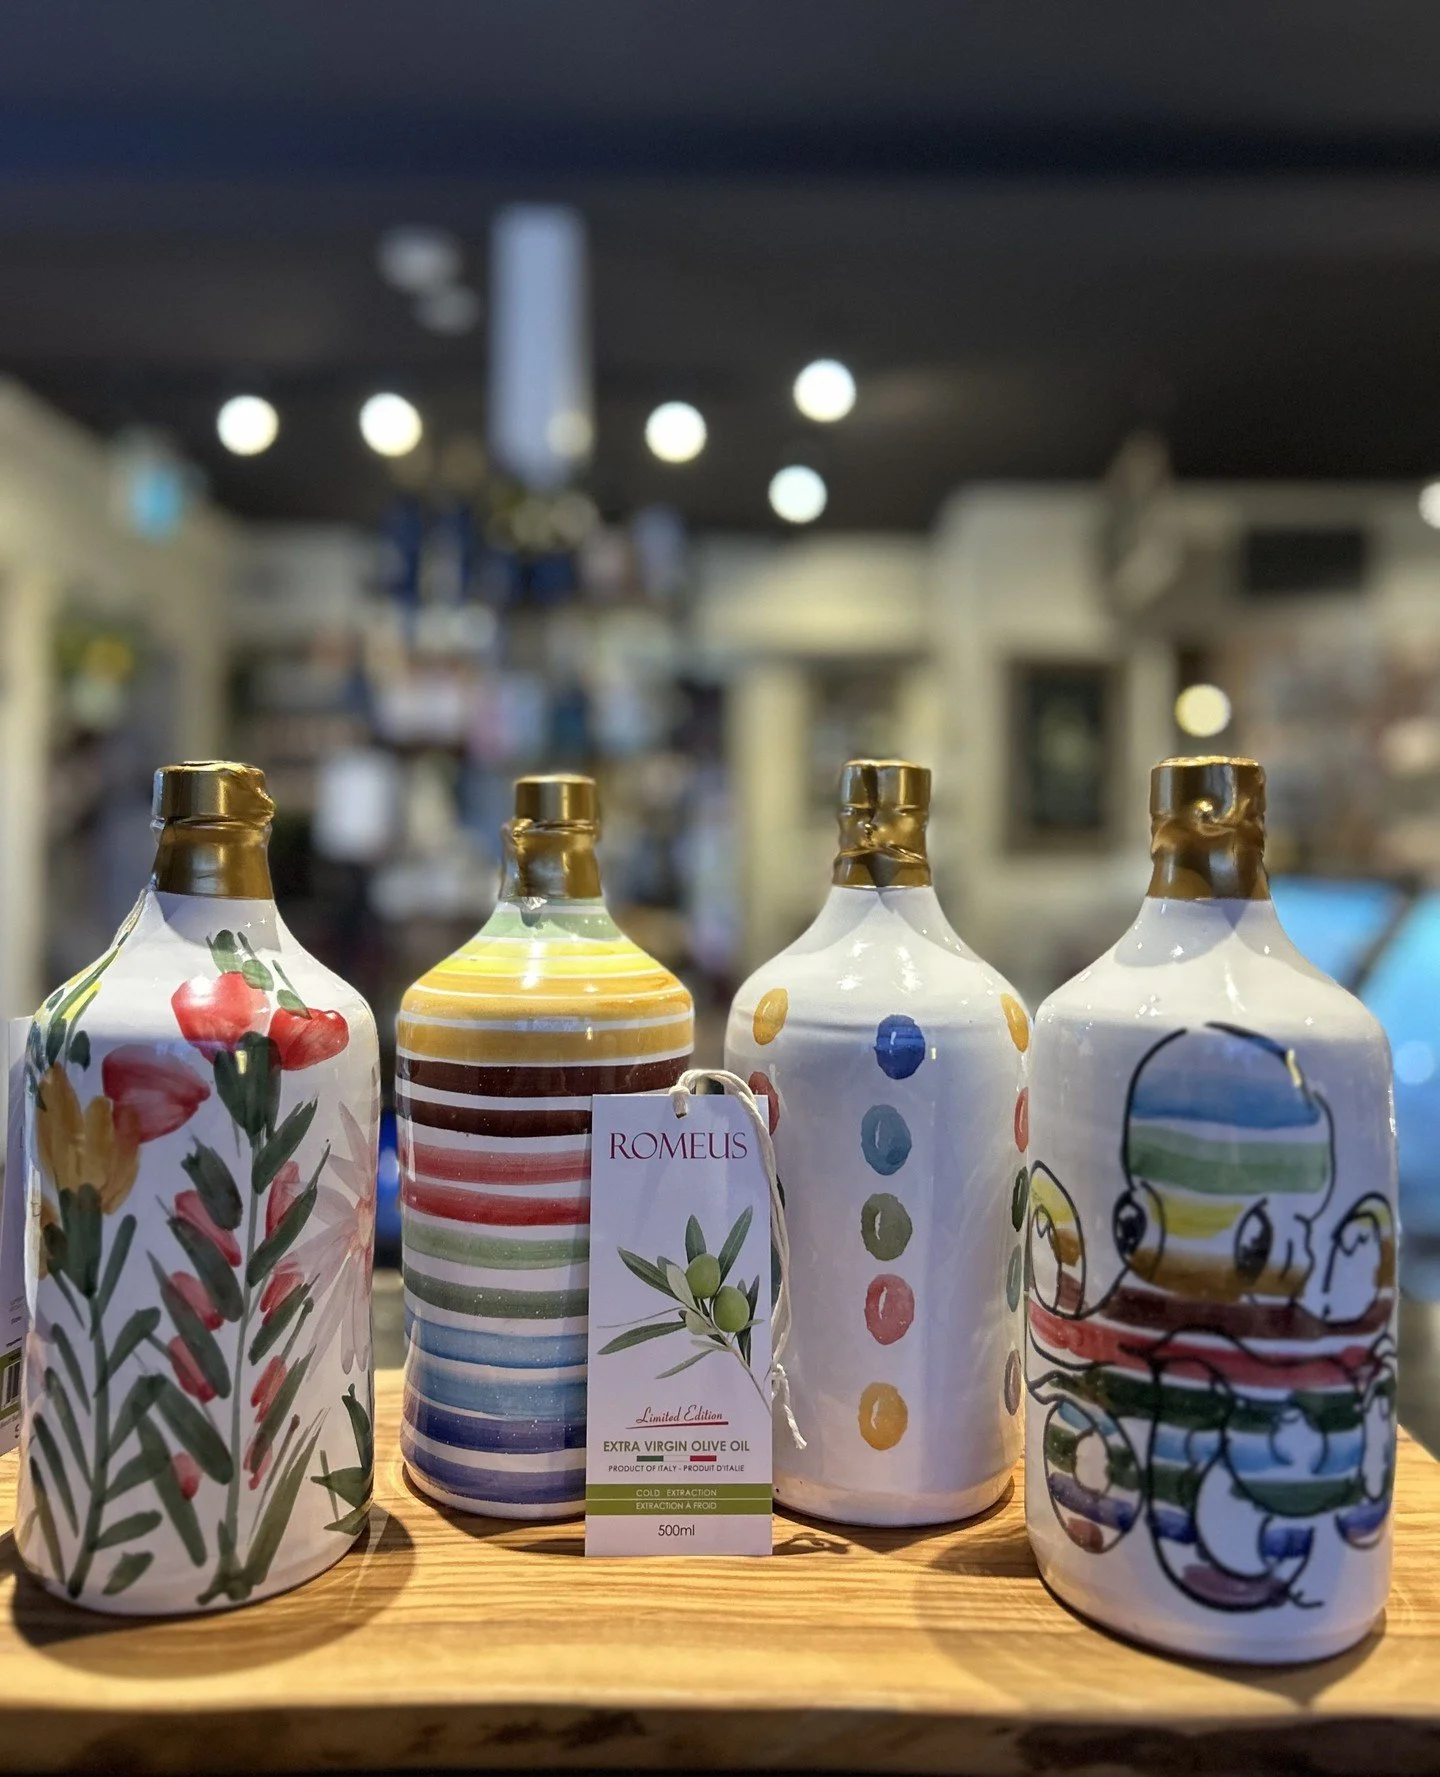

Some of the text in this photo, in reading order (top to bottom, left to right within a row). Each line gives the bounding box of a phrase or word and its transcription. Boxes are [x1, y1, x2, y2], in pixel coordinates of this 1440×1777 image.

[609, 1131, 748, 1160] ROMEUS
[635, 1404, 723, 1424] Limited Edition
[603, 1440, 750, 1452] EXTRA VIRGIN OLIVE OIL
[683, 1464, 715, 1472] PRODUIT
[716, 1464, 745, 1472] D'ITALIE
[636, 1489, 717, 1497] COLD EXTRACTION
[636, 1502, 684, 1510] EXTRACTION
[693, 1502, 717, 1510] FROID
[657, 1524, 695, 1537] 500ml
